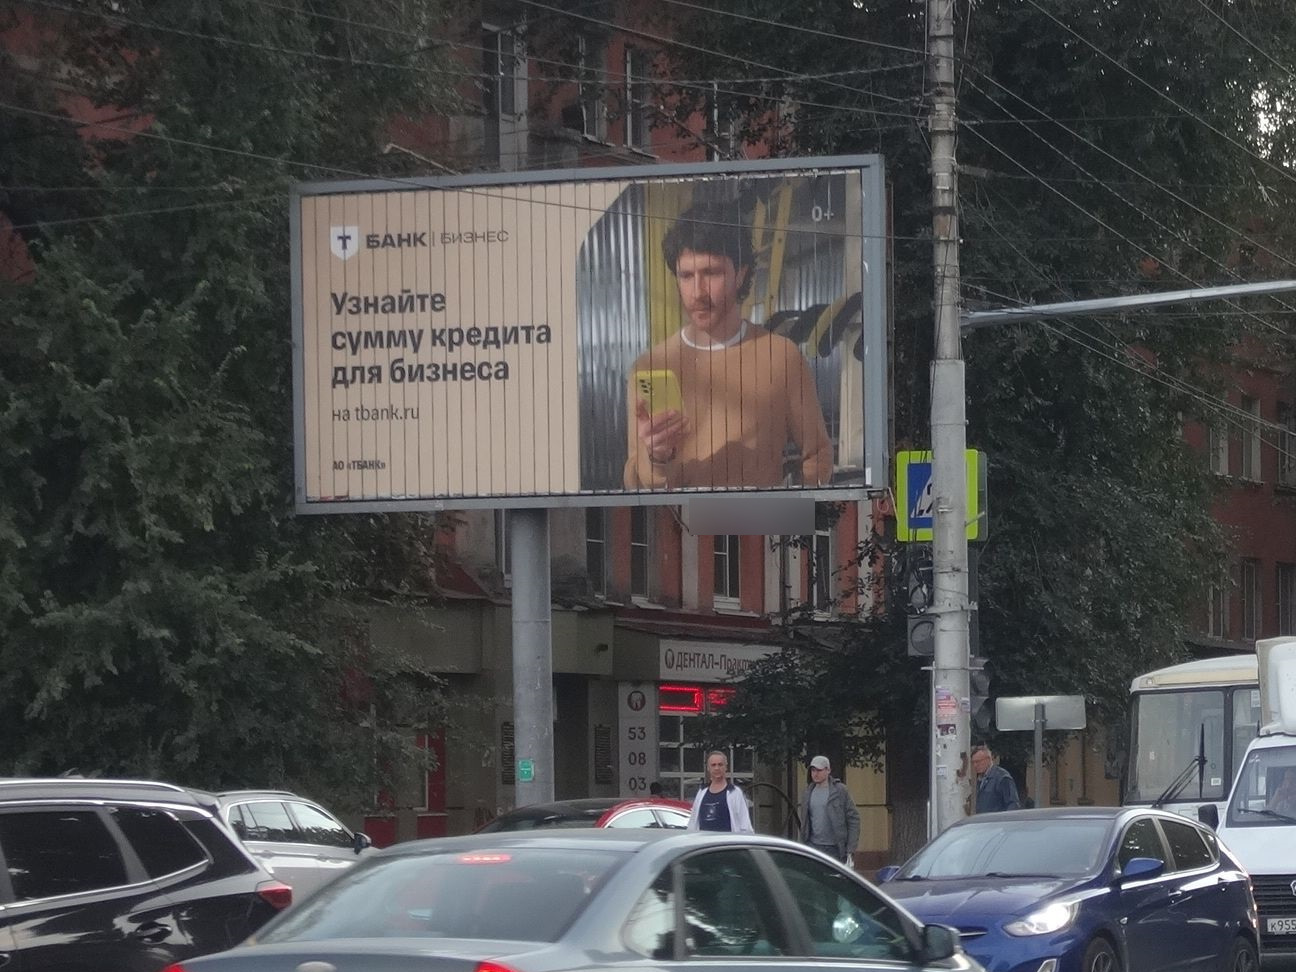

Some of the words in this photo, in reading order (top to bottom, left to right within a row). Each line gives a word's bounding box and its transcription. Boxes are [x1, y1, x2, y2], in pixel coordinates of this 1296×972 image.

[366, 232, 427, 249] БАНК
[440, 230, 509, 245] БИЗНЕС
[331, 289, 446, 315] Узнайте
[331, 329, 424, 356] сумму
[431, 323, 552, 352] кредита
[331, 365, 382, 388] для
[390, 358, 509, 384] бизнеса
[332, 409, 350, 421] на
[355, 404, 420, 421] tbank.ru
[333, 460, 344, 470] АО
[628, 726, 646, 740] 53
[628, 752, 647, 765] 08
[629, 777, 647, 791] 03
